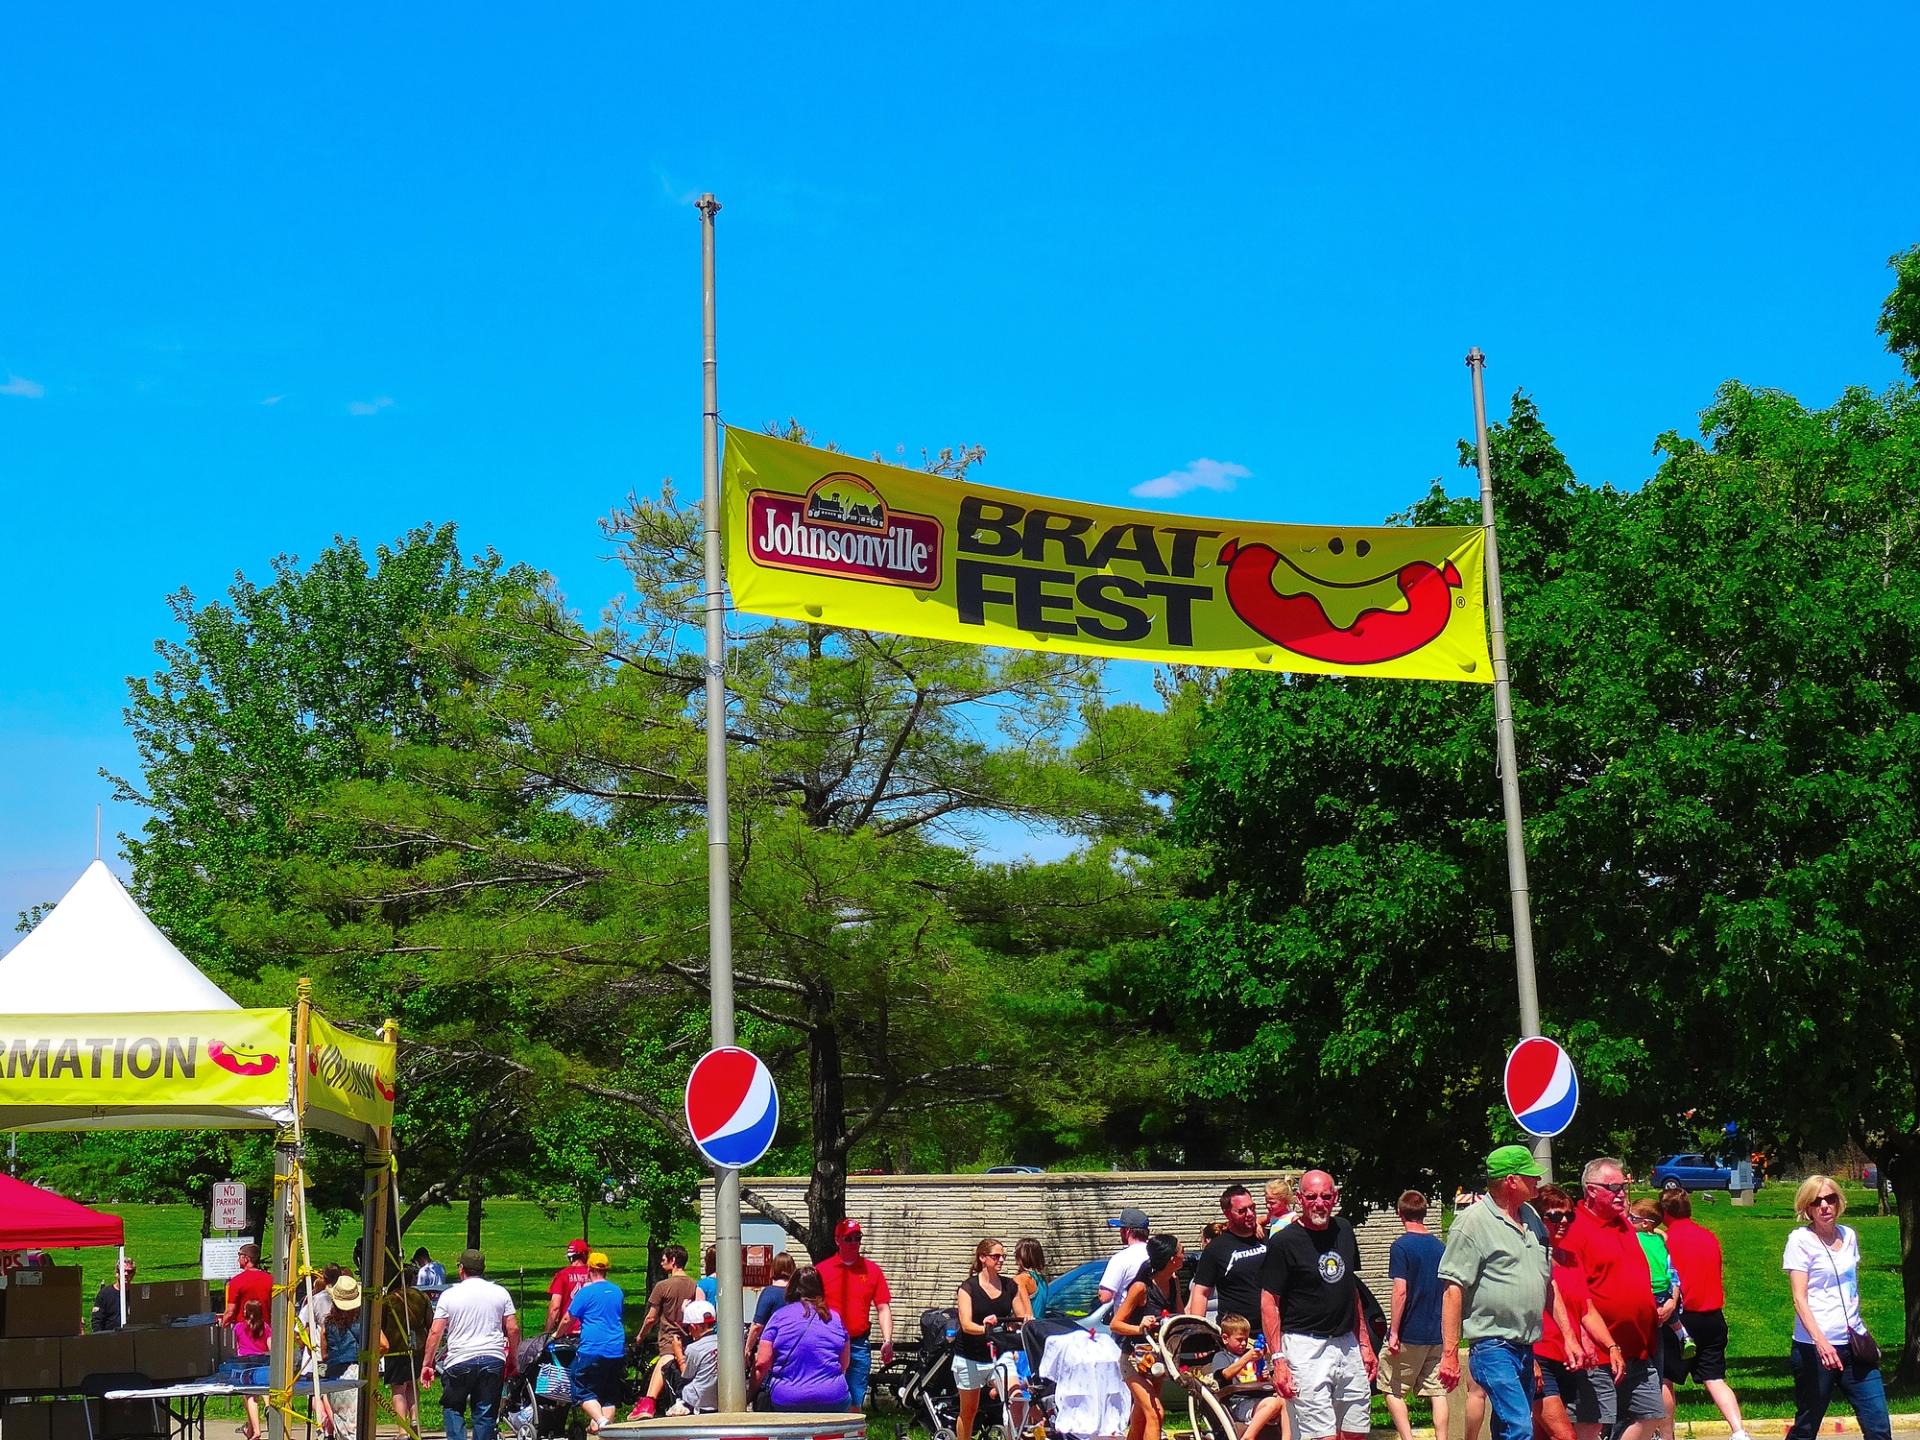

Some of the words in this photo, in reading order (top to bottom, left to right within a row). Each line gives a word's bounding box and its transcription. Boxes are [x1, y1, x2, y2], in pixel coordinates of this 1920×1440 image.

[759, 508, 928, 574] Johnsonville
[958, 496, 1224, 578] BRAT
[956, 559, 1213, 646] FEST
[0, 1037, 198, 1079] MATION
[216, 1198, 243, 1206] PARKING
[223, 1186, 236, 1197] NO
[222, 1216, 237, 1225] TIME
[223, 1207, 236, 1215] ANY
